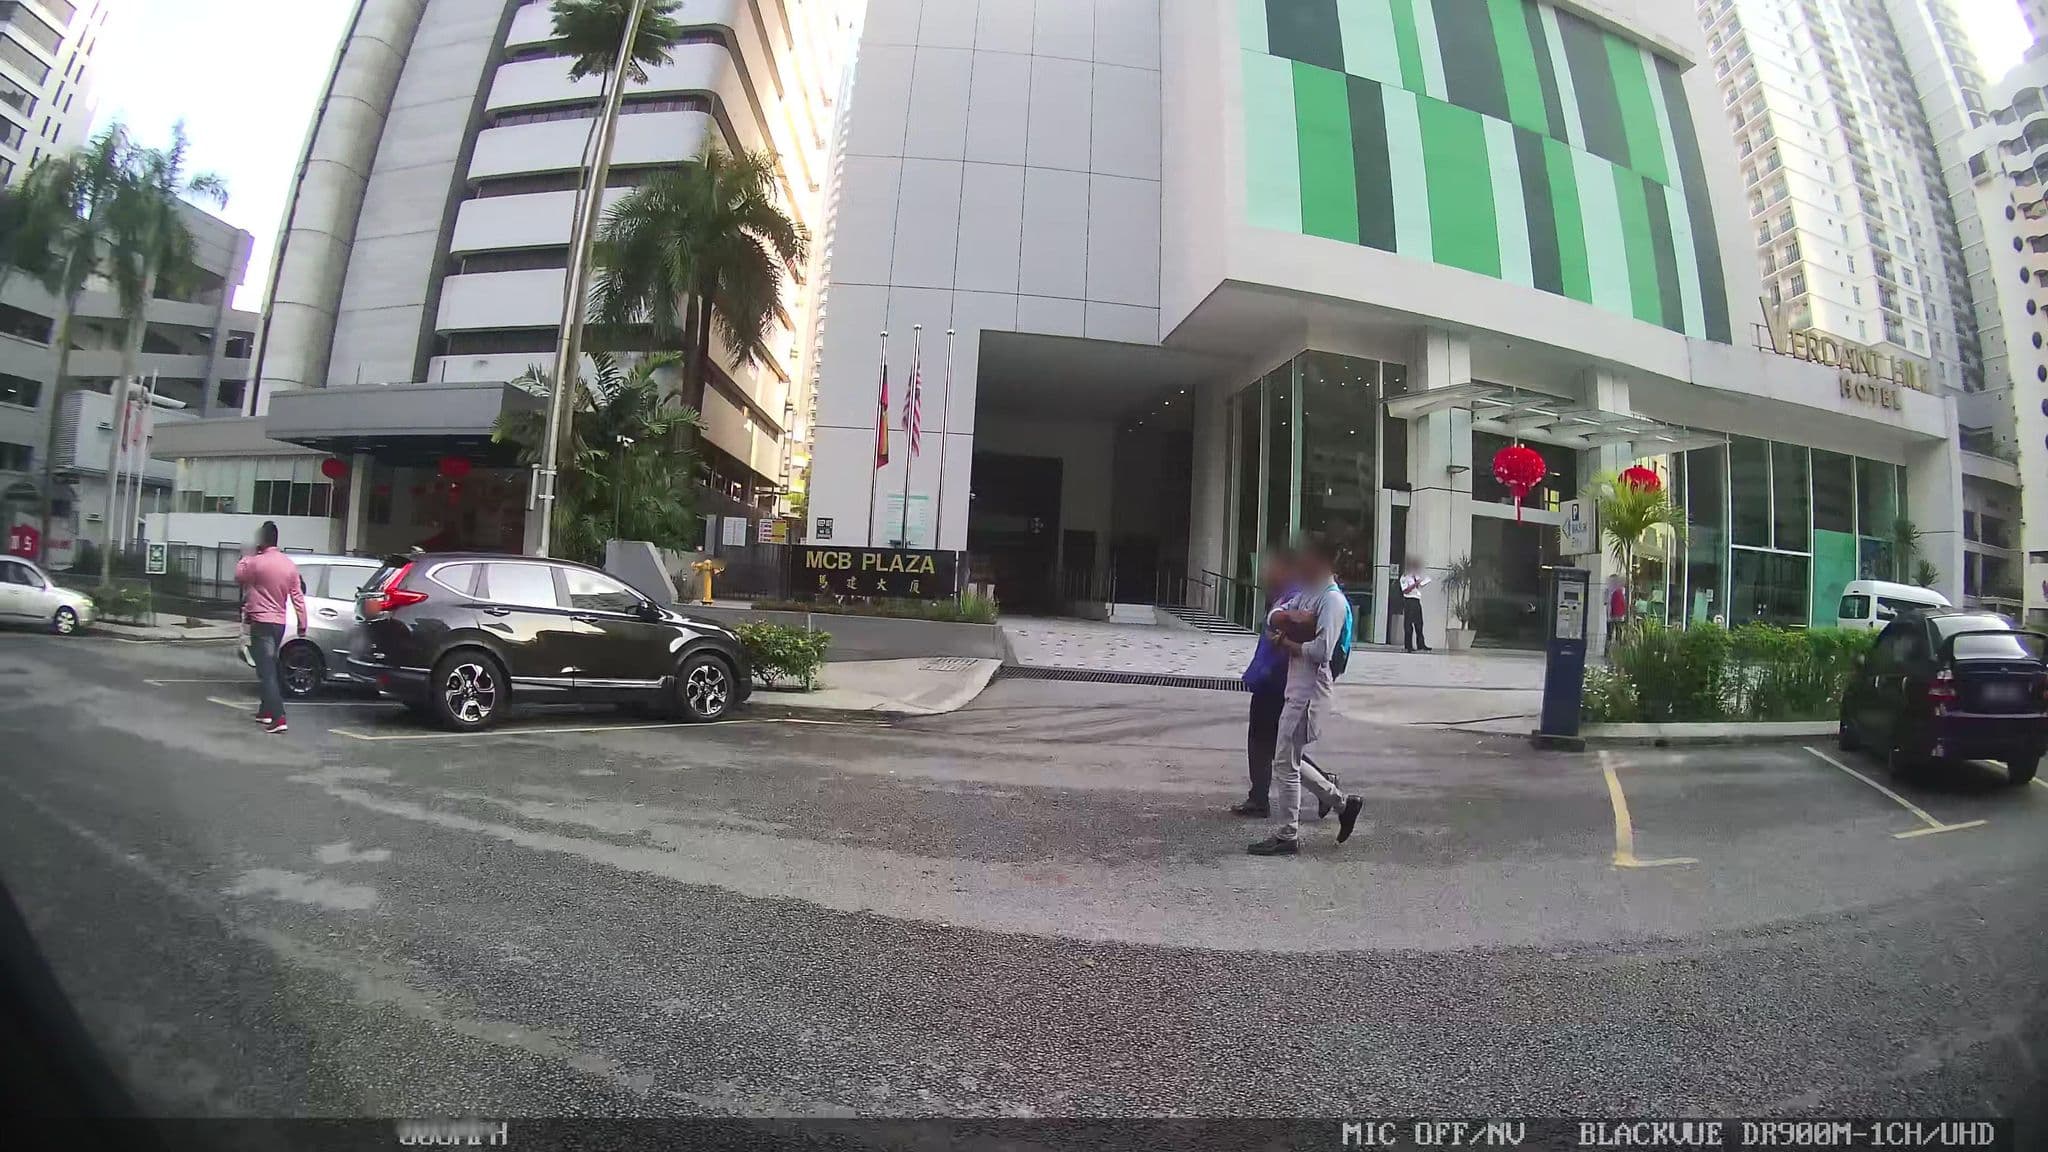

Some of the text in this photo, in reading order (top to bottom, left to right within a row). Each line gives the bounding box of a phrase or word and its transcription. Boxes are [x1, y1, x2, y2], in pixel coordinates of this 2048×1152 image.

[1759, 297, 1884, 380] VERDANT
[1840, 375, 1902, 411] HOTEL
[805, 550, 936, 574] MCB PLAZA
